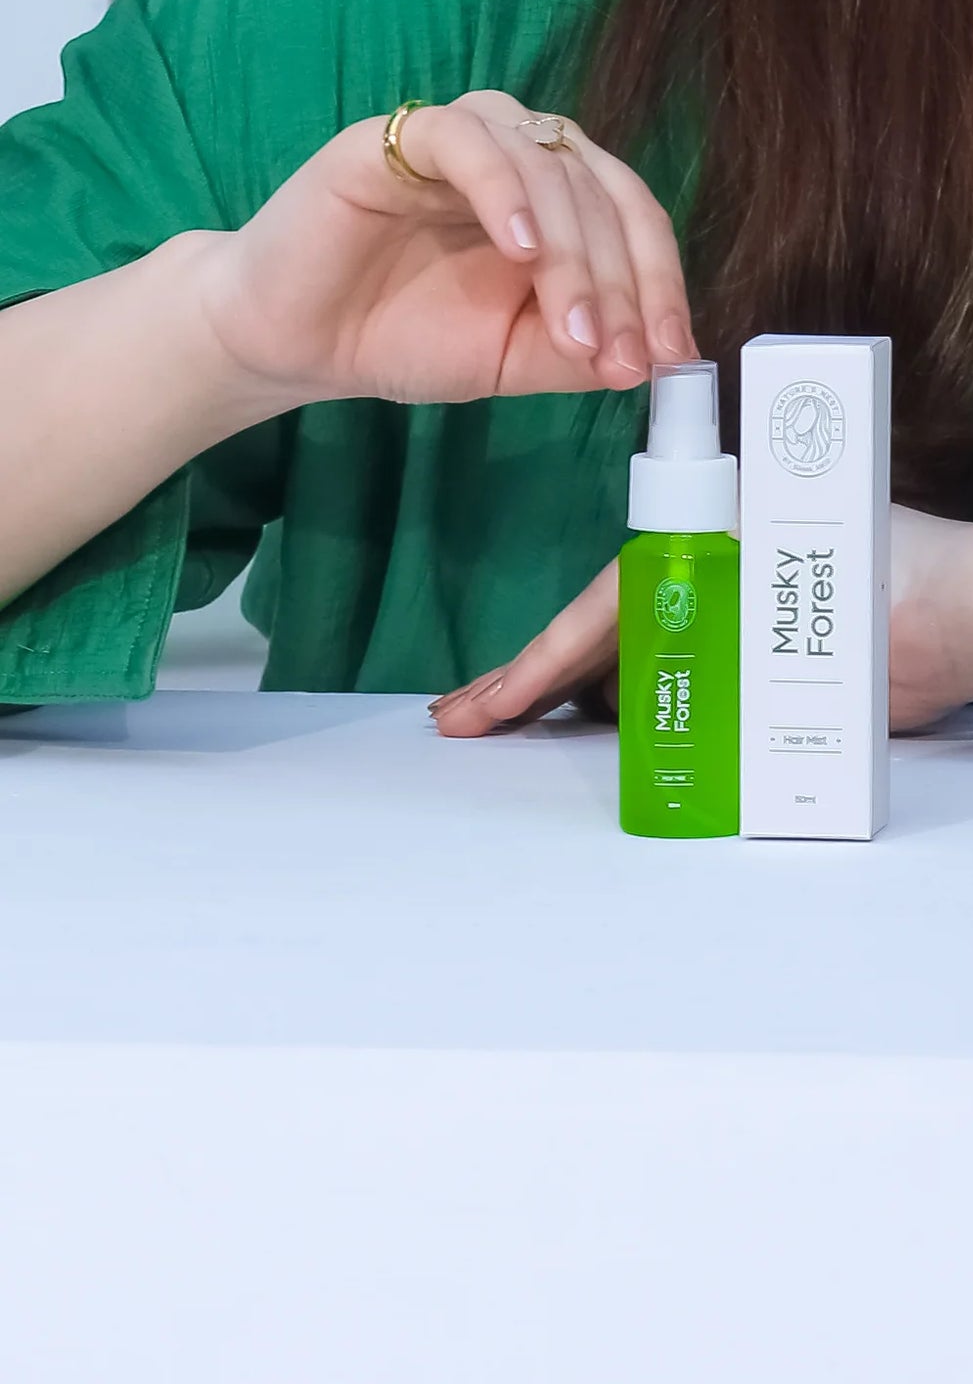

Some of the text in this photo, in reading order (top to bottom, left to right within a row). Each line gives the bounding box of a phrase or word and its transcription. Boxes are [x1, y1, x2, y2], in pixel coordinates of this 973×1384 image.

[771, 548, 804, 653] Musky
[806, 548, 834, 656] Forest
[655, 671, 675, 731] Musky
[674, 670, 690, 732] Forest
